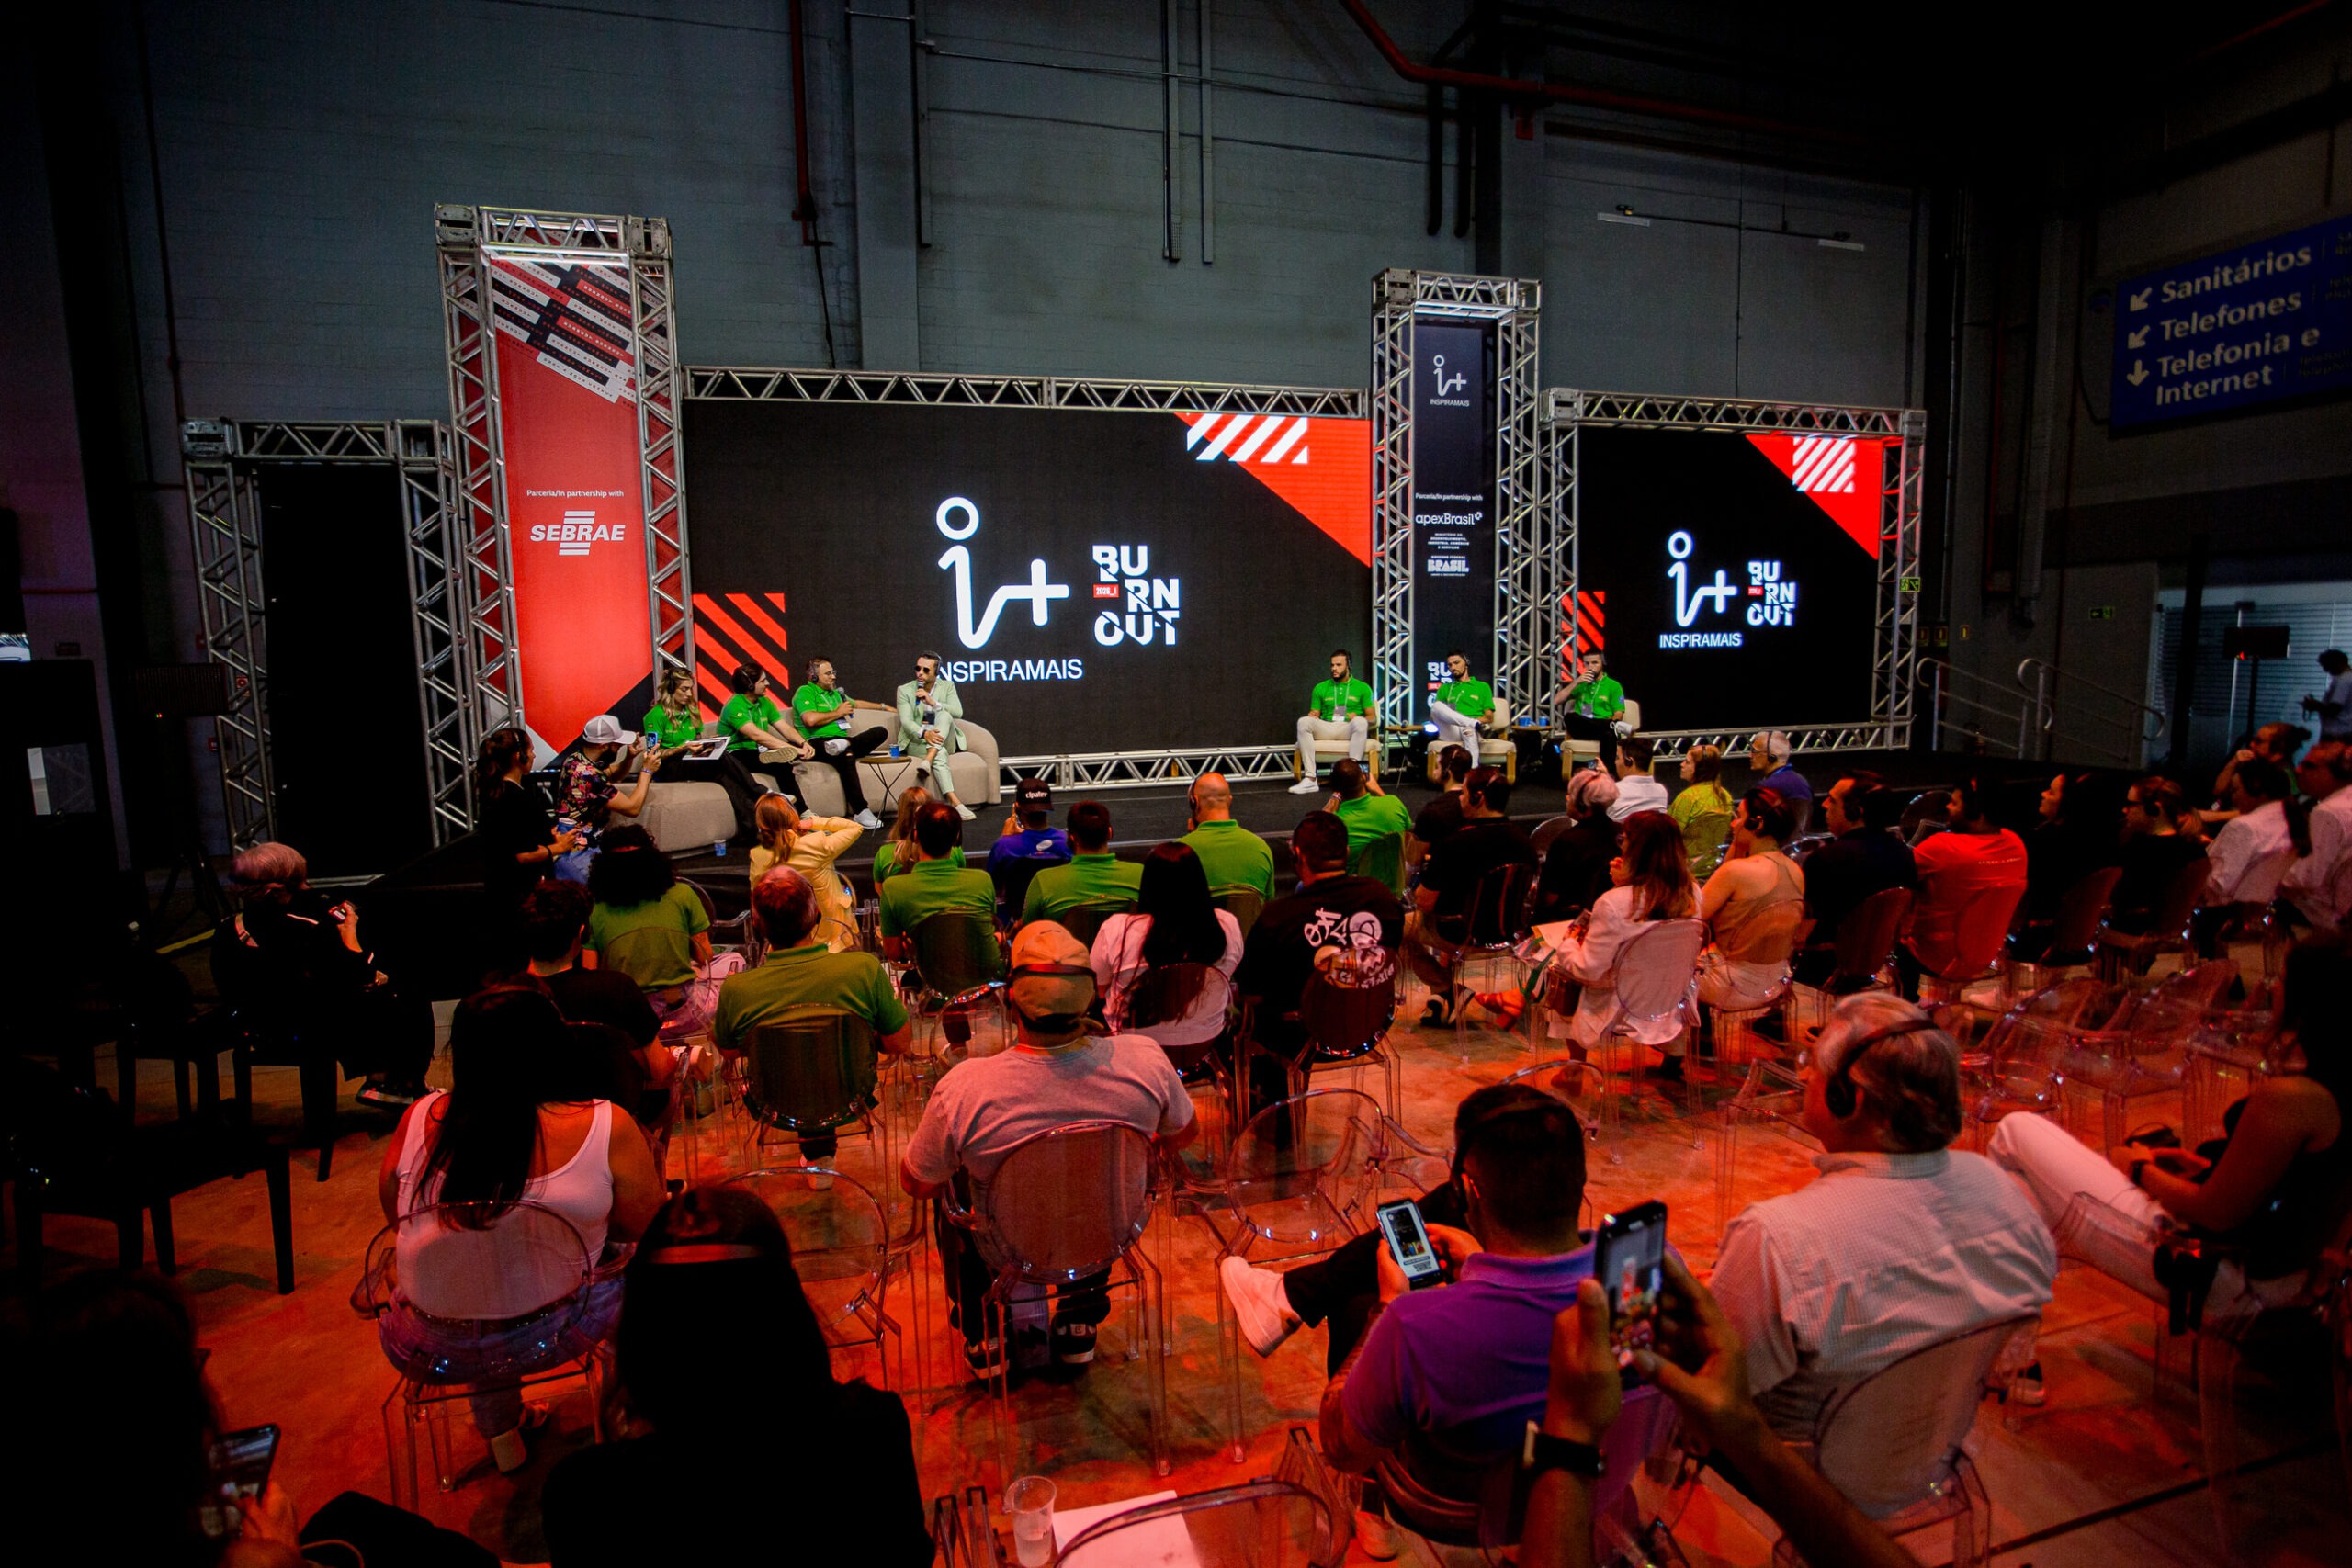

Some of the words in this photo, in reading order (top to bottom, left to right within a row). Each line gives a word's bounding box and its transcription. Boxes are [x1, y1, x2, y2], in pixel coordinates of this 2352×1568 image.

[2161, 246, 2312, 303] Sanitários
[2160, 291, 2302, 341] Telefones
[2157, 331, 2291, 378] Telefonia
[2301, 327, 2321, 348] e
[2155, 364, 2274, 406] Internet
[1430, 398, 1470, 407] INSPIRAMAIS
[526, 489, 565, 498] Parceria/In
[567, 490, 607, 499] partnership
[1415, 513, 1476, 526] apexBrasil
[530, 525, 626, 542] SEBRAE
[1427, 559, 1470, 573] BRASIL
[1659, 632, 1743, 649] INSPIRAMAIS
[938, 658, 1084, 683] NSPIRAMAIS
